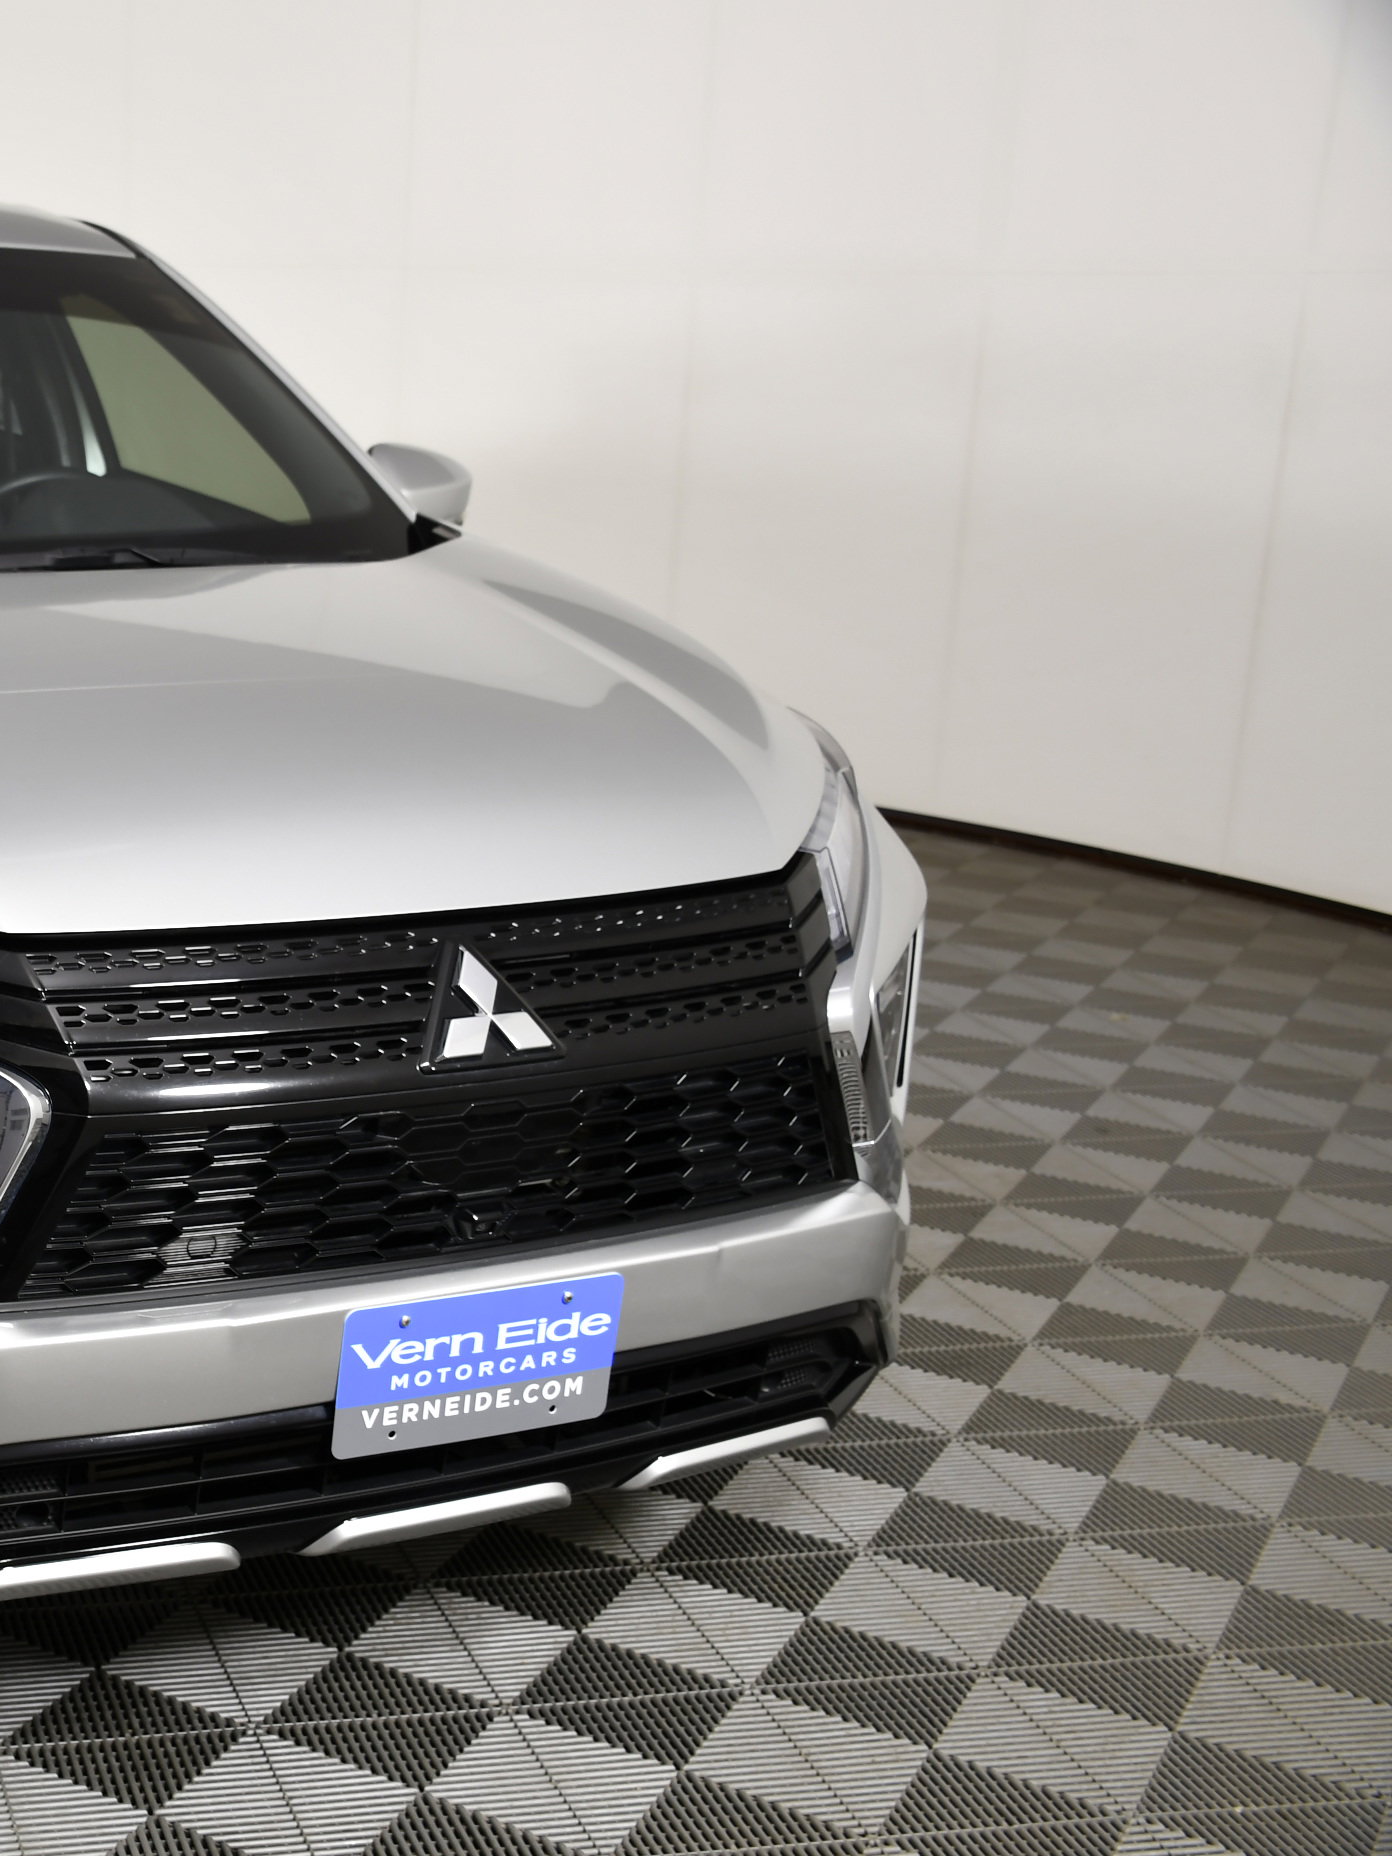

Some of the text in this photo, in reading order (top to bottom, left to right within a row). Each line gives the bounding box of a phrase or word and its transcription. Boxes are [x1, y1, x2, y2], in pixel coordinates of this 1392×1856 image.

[350, 1311, 611, 1369] Vern Eide
[389, 1347, 577, 1391] MOTORCARS
[361, 1375, 584, 1429] VERNEIDE.COM
